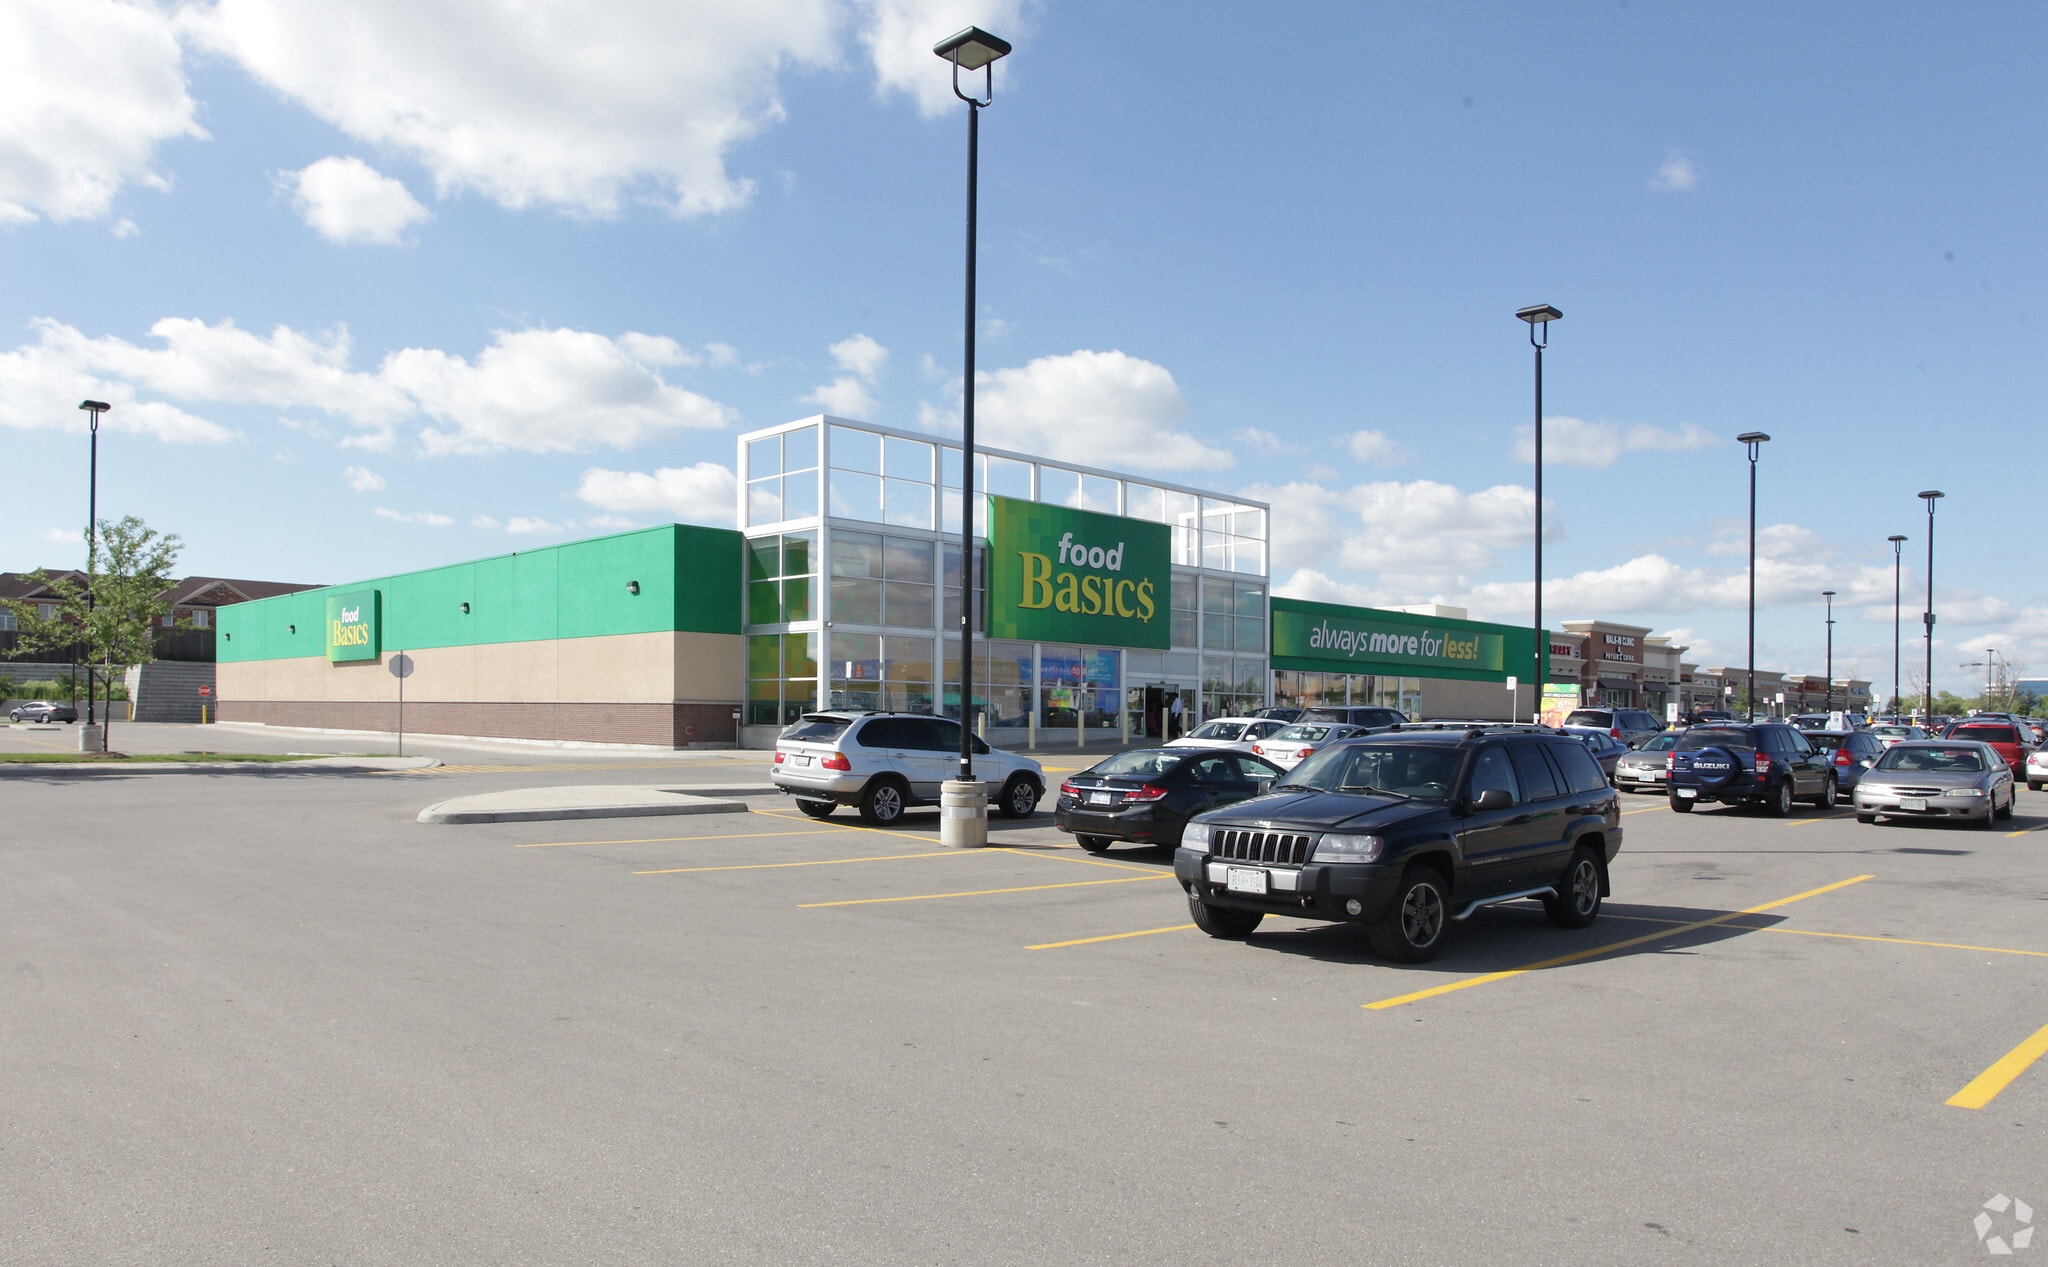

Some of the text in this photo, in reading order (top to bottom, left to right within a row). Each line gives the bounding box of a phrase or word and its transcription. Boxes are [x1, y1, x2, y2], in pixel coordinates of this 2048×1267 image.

[1058, 532, 1124, 571] food
[342, 606, 359, 623] food
[1309, 620, 1479, 660] always more for less!
